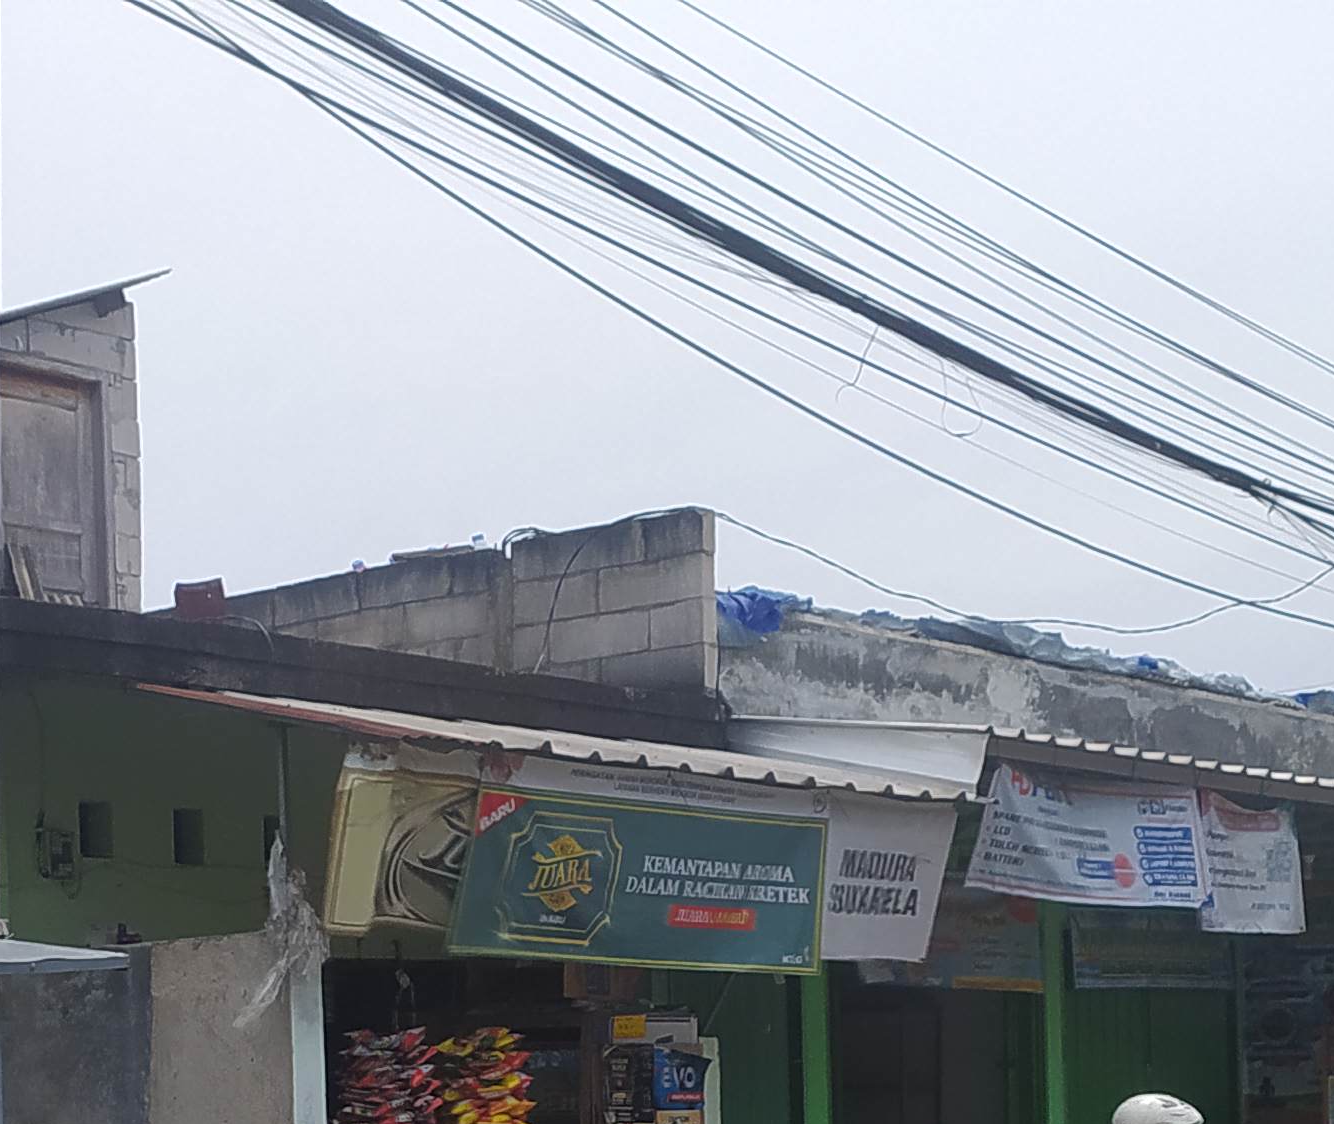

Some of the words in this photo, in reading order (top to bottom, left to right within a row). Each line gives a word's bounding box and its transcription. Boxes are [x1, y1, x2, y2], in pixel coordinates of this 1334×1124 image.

[479, 797, 517, 831] BARU
[993, 825, 1012, 836] LCD
[528, 858, 593, 891] JUARA
[643, 855, 743, 880] KEMANTAPAN
[743, 863, 795, 884] AROMA
[839, 848, 917, 882] MADURA
[625, 875, 679, 897] DALAM
[746, 885, 812, 905] KRETEK
[662, 1065, 696, 1089] EVO
